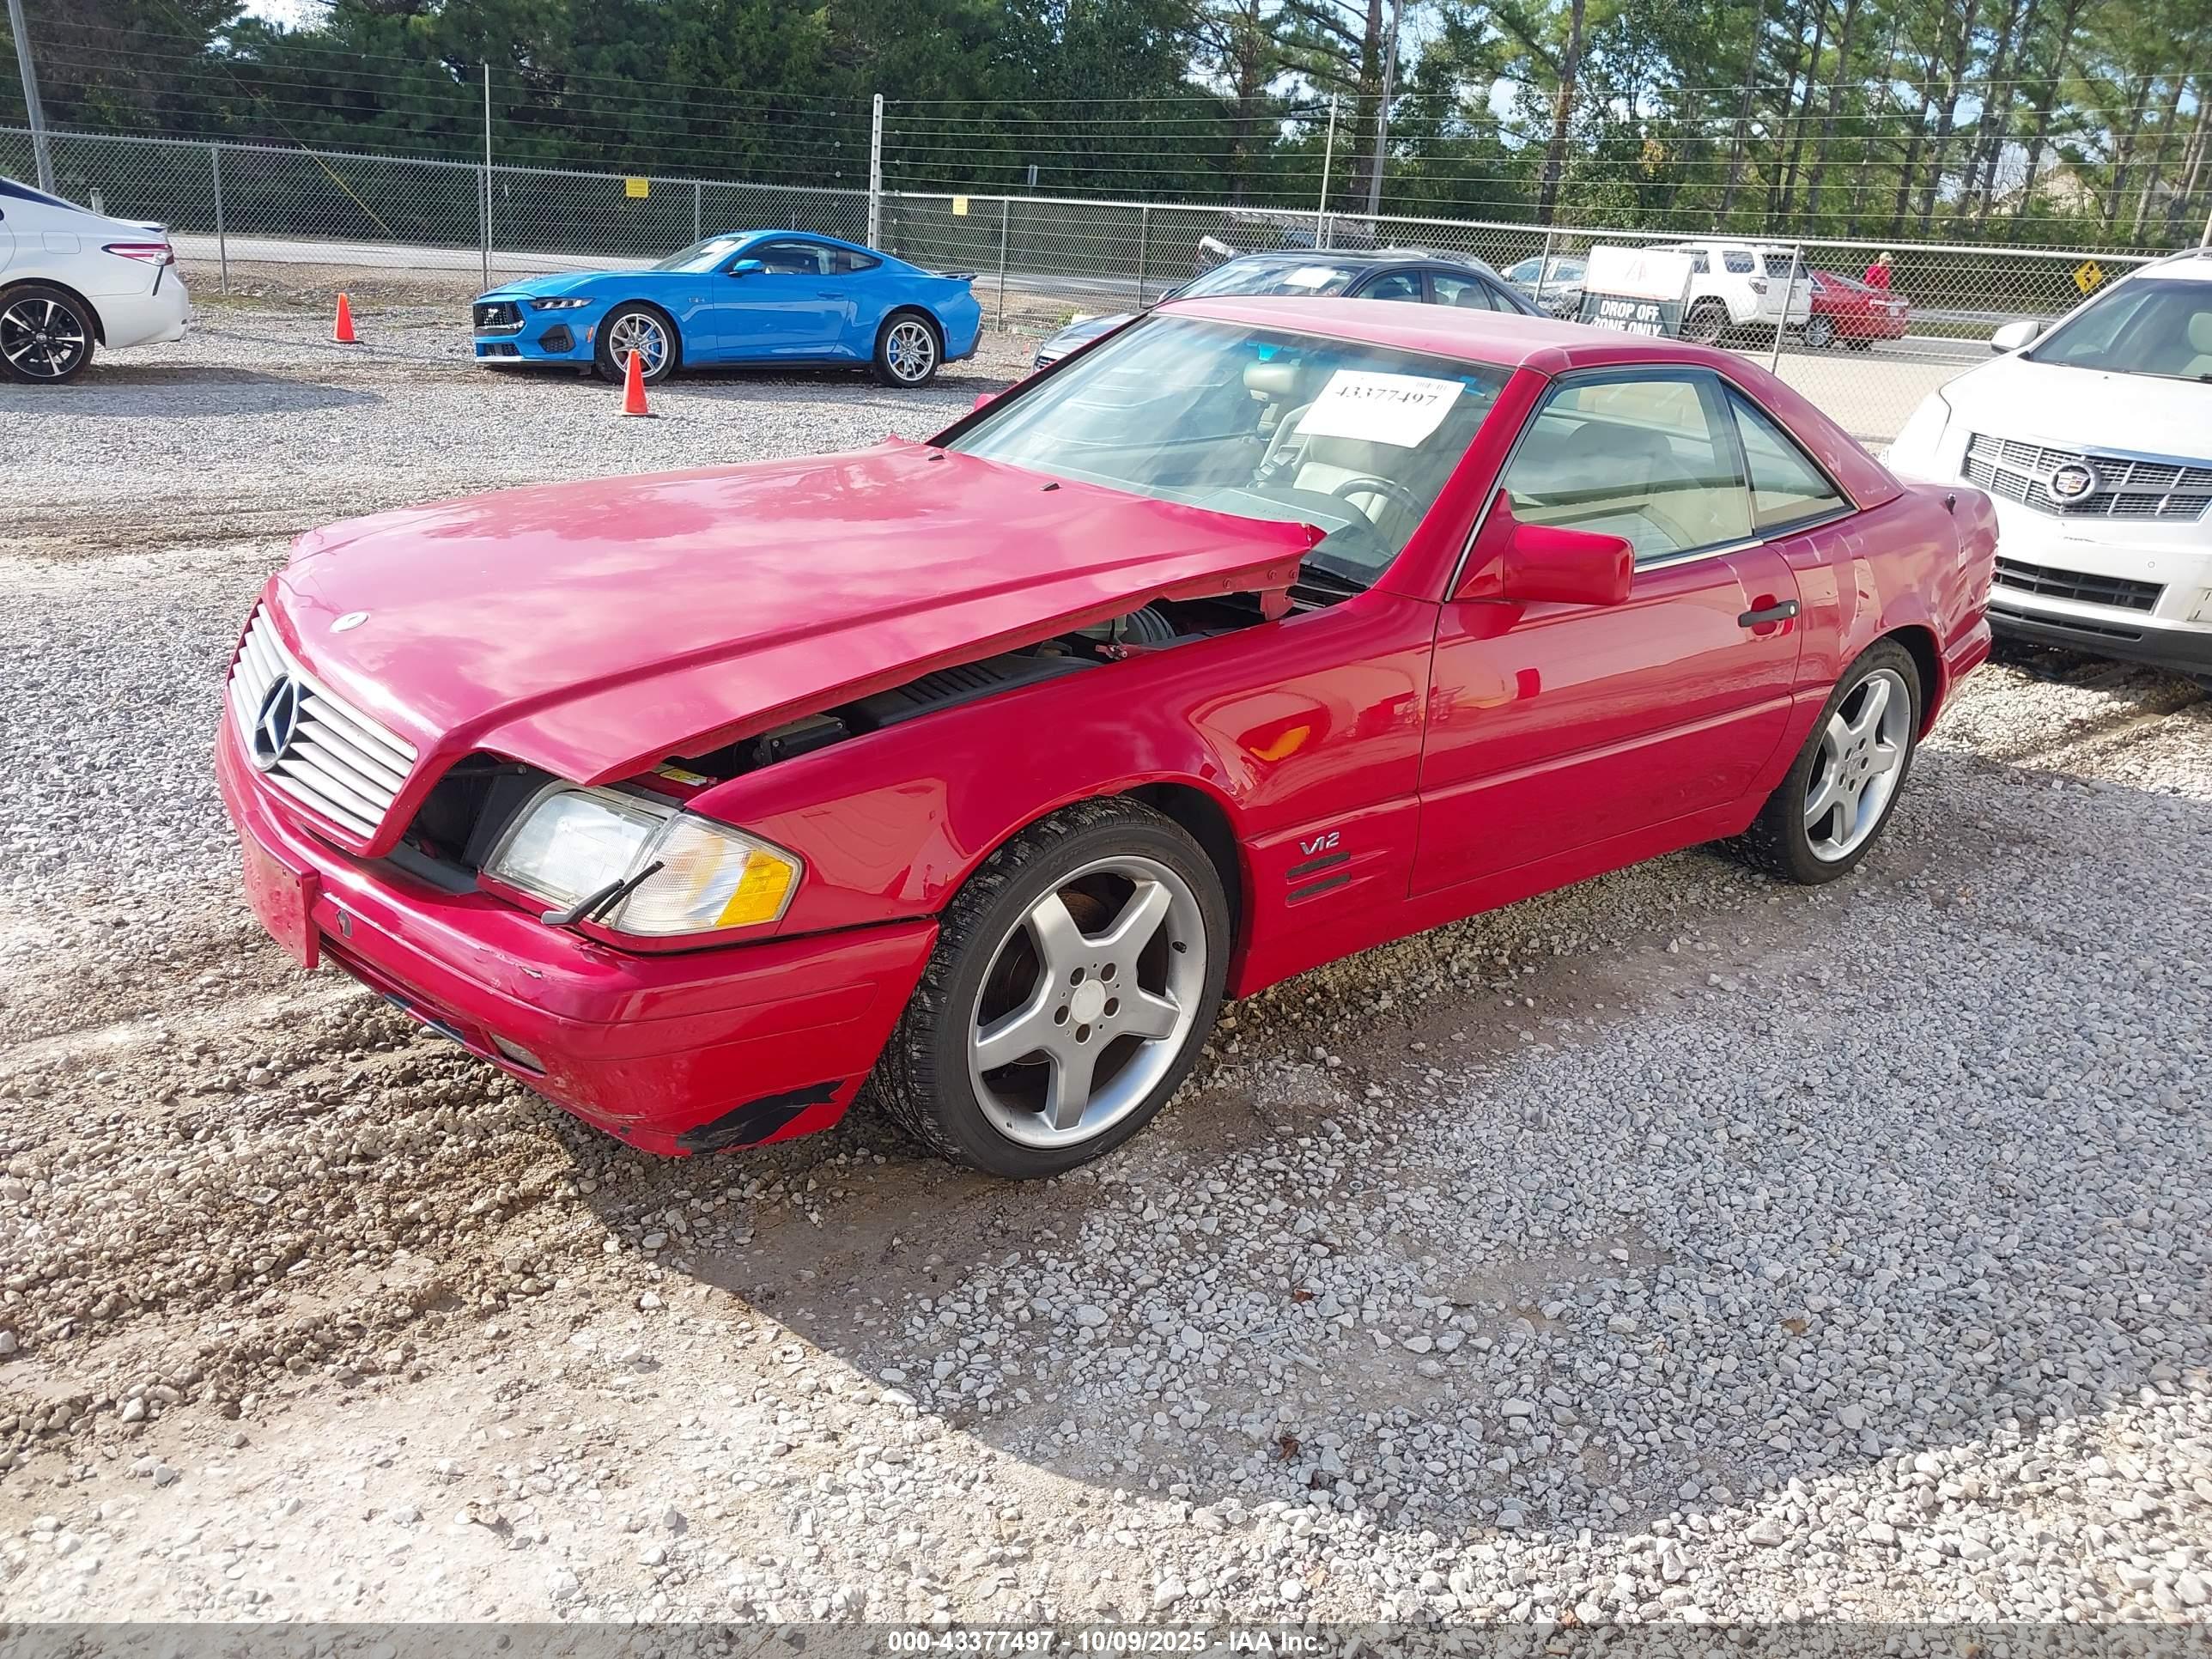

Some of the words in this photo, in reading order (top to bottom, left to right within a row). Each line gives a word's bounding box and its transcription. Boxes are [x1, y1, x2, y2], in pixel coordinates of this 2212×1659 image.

[1600, 300, 1636, 319] DROP
[1636, 304, 1660, 322] OFF
[1627, 321, 1662, 337] ONLY
[1335, 386, 1438, 406] 43377497
[1299, 831, 1340, 855] V12
